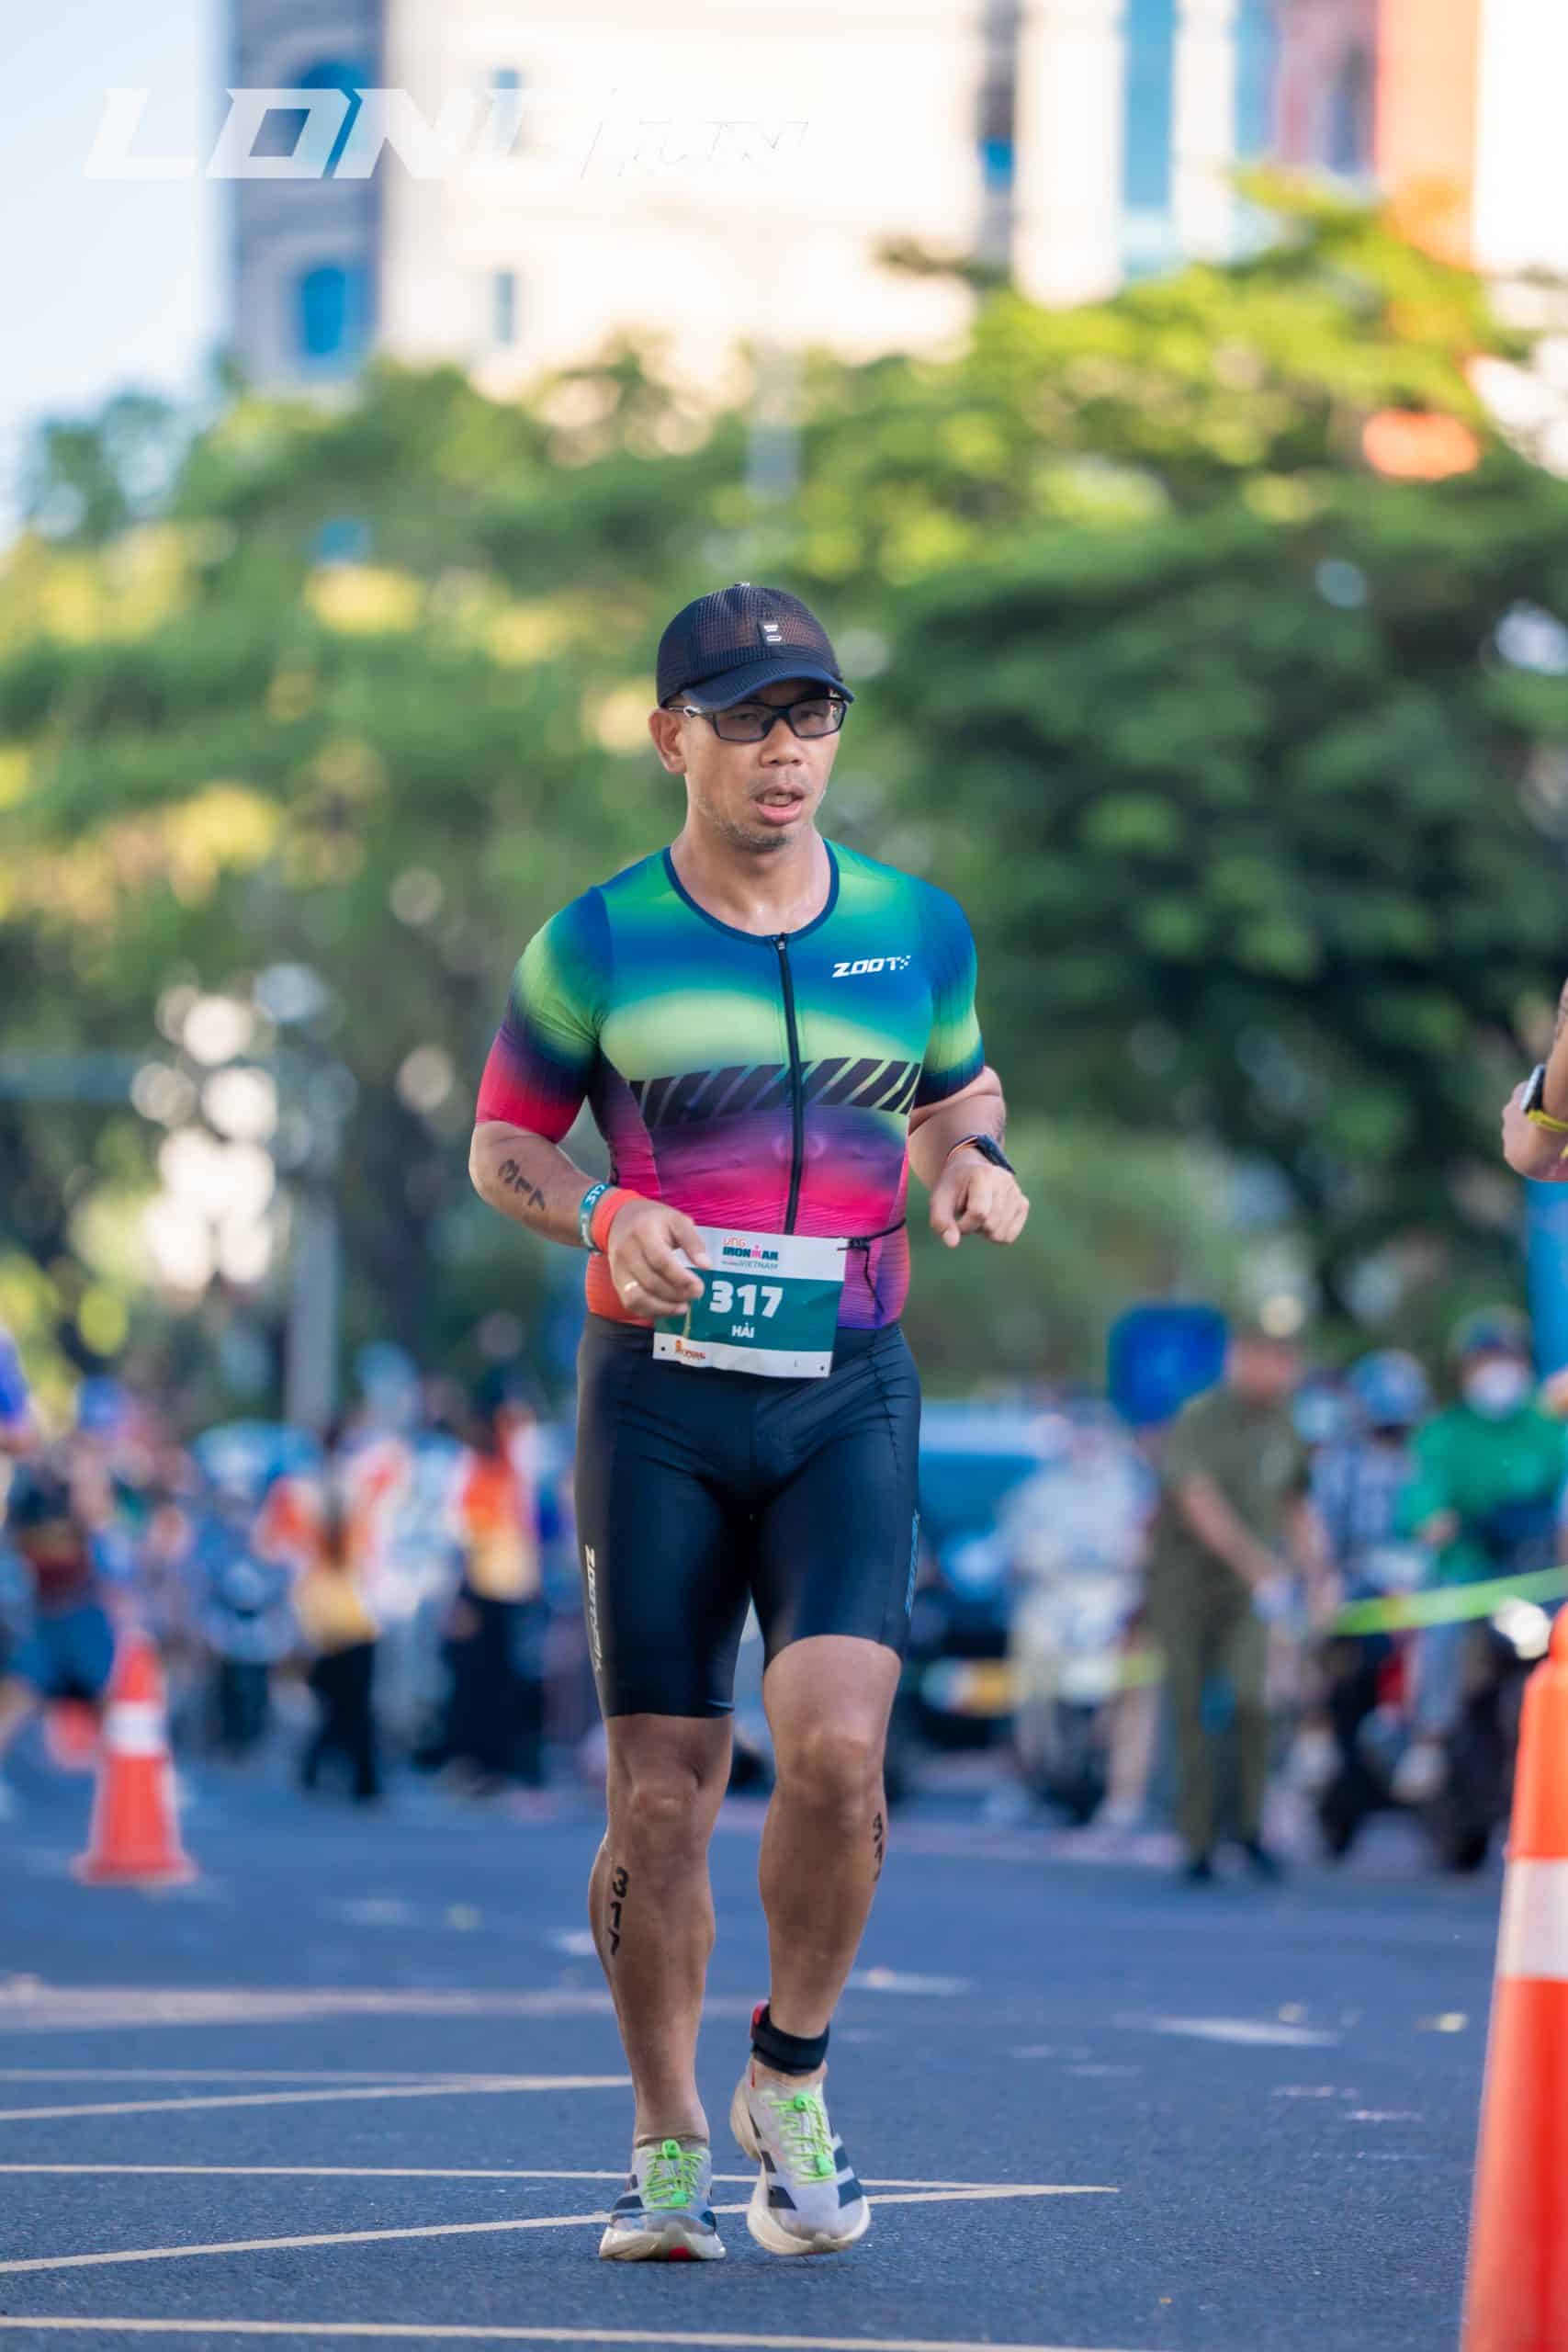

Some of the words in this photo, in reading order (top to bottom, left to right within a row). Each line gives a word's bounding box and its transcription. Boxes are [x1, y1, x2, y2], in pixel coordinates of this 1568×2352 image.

[831, 956, 904, 978] ZOOT
[722, 1244, 779, 1261] IRONMAN
[709, 1280, 784, 1318] 317
[607, 1866, 629, 1956] 317
